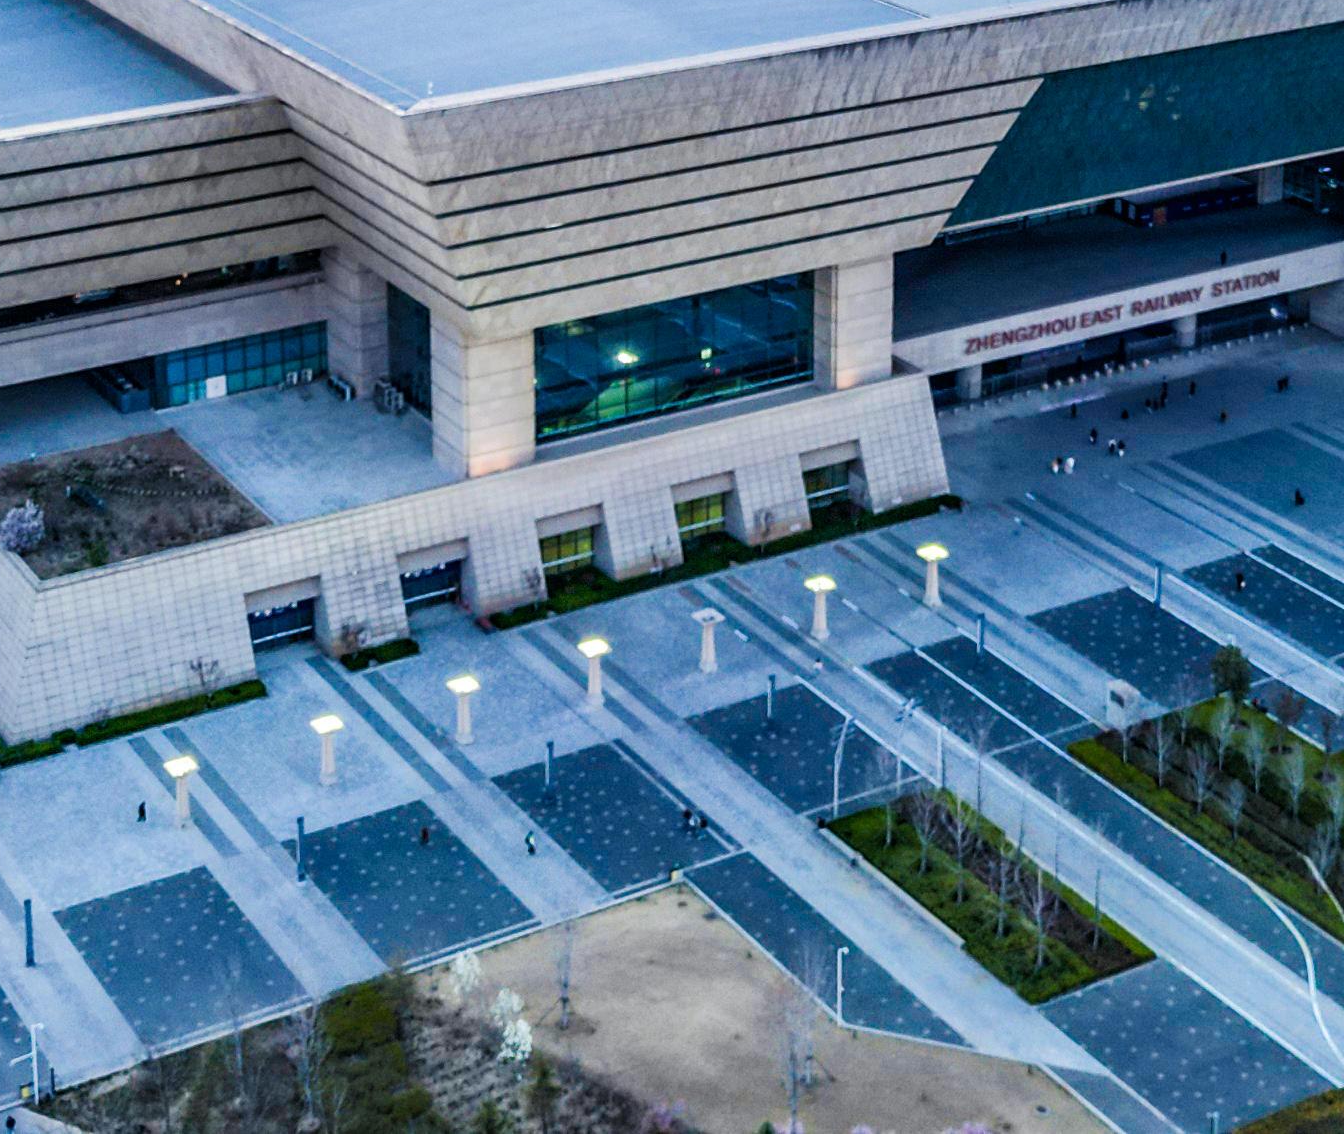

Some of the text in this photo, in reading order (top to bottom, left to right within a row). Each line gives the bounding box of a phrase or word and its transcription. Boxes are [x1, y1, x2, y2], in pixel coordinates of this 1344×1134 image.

[964, 269, 1280, 355] ZHENGZHOU EAST RAILWAY STATION
